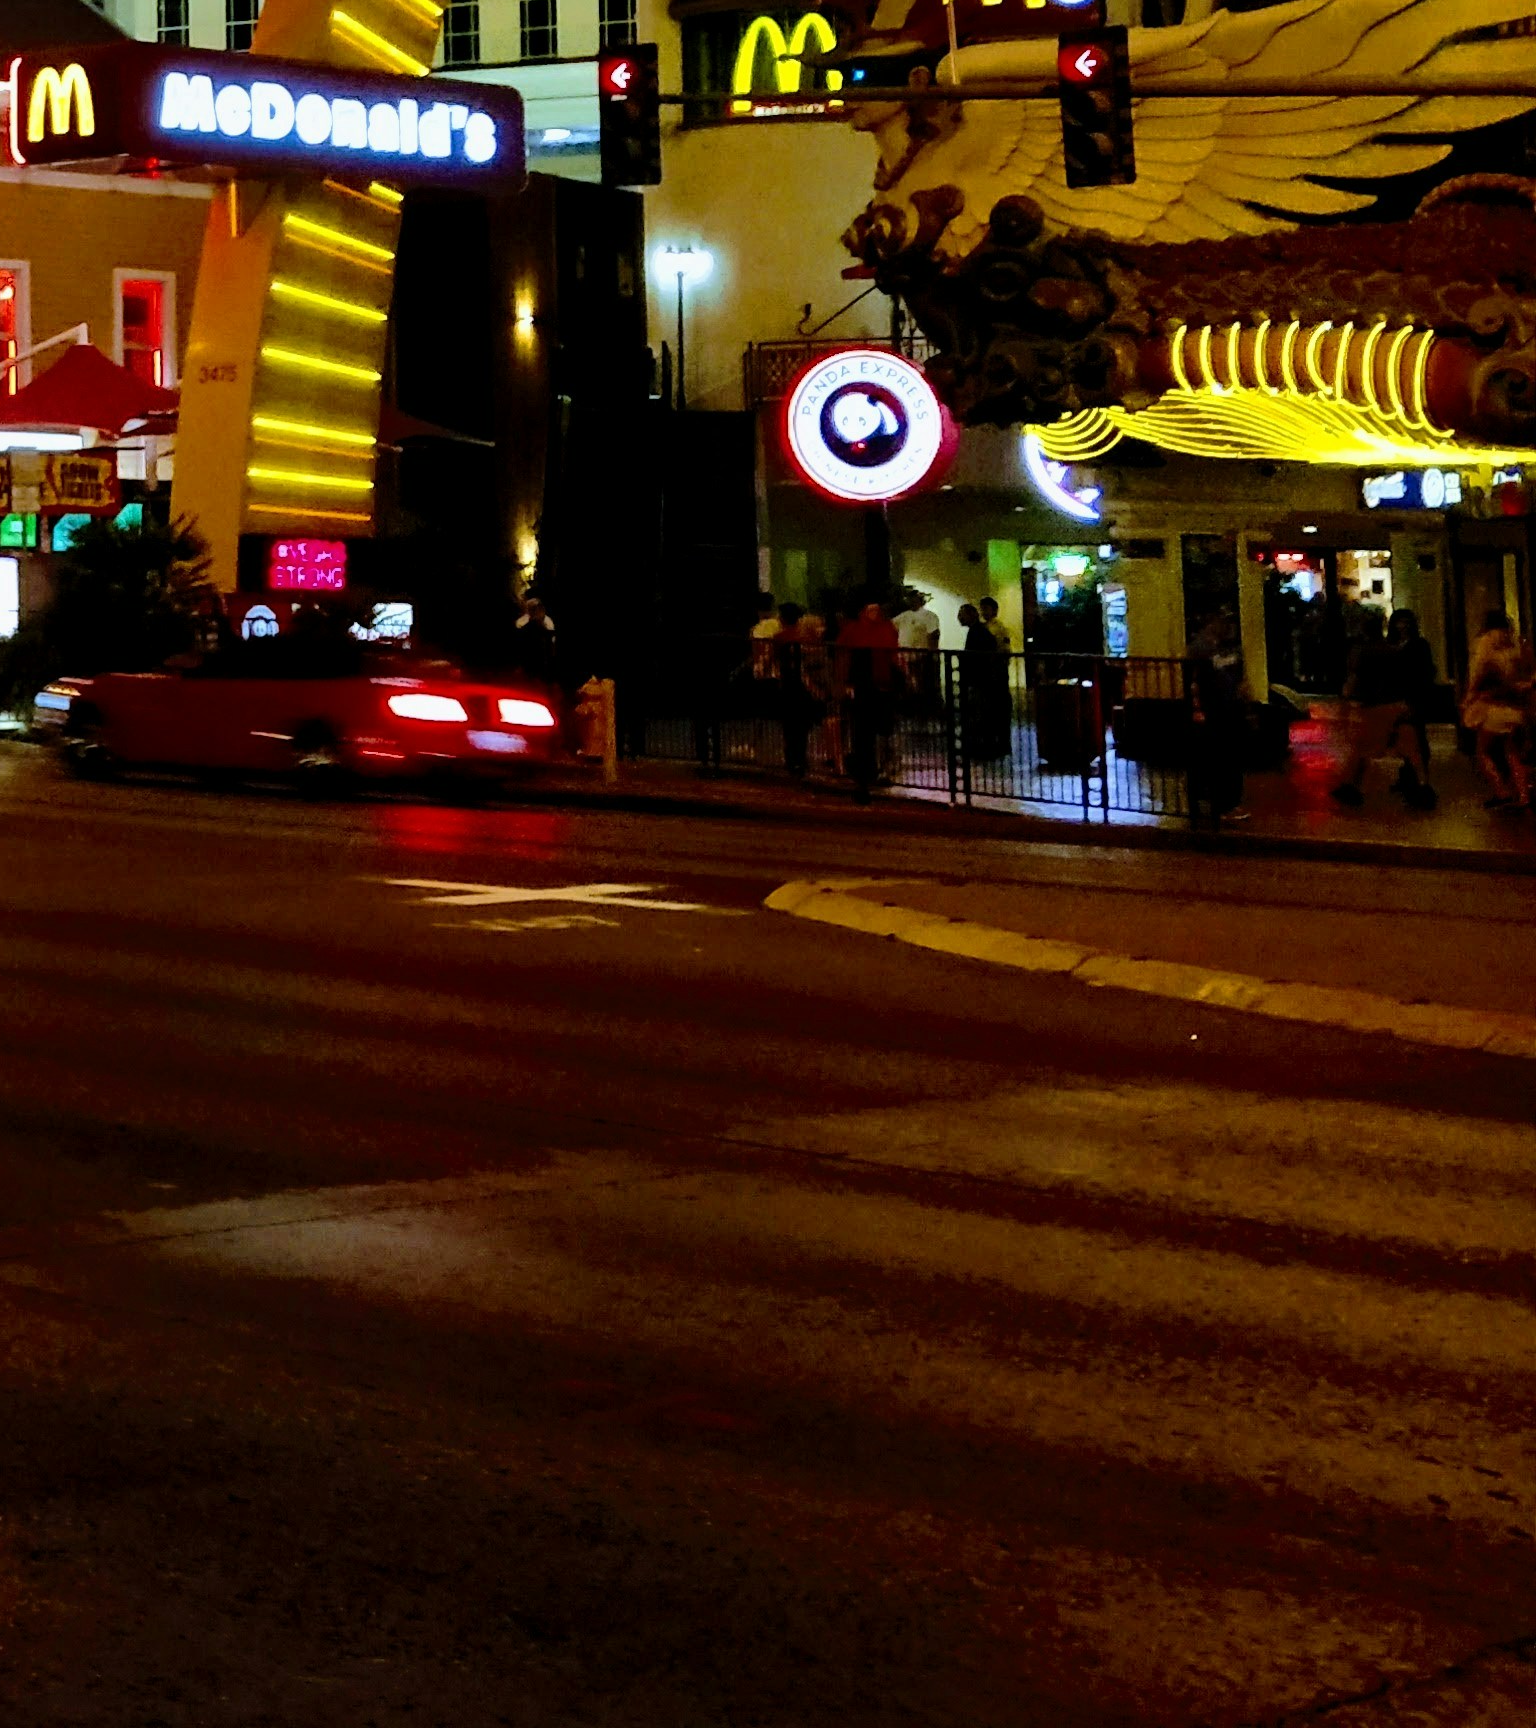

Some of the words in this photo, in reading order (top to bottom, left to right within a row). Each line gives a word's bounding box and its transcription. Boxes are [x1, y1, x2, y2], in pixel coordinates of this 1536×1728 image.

[159, 71, 498, 163] McDonald's
[801, 365, 851, 416] PANDA
[859, 360, 929, 421] EXPRESS
